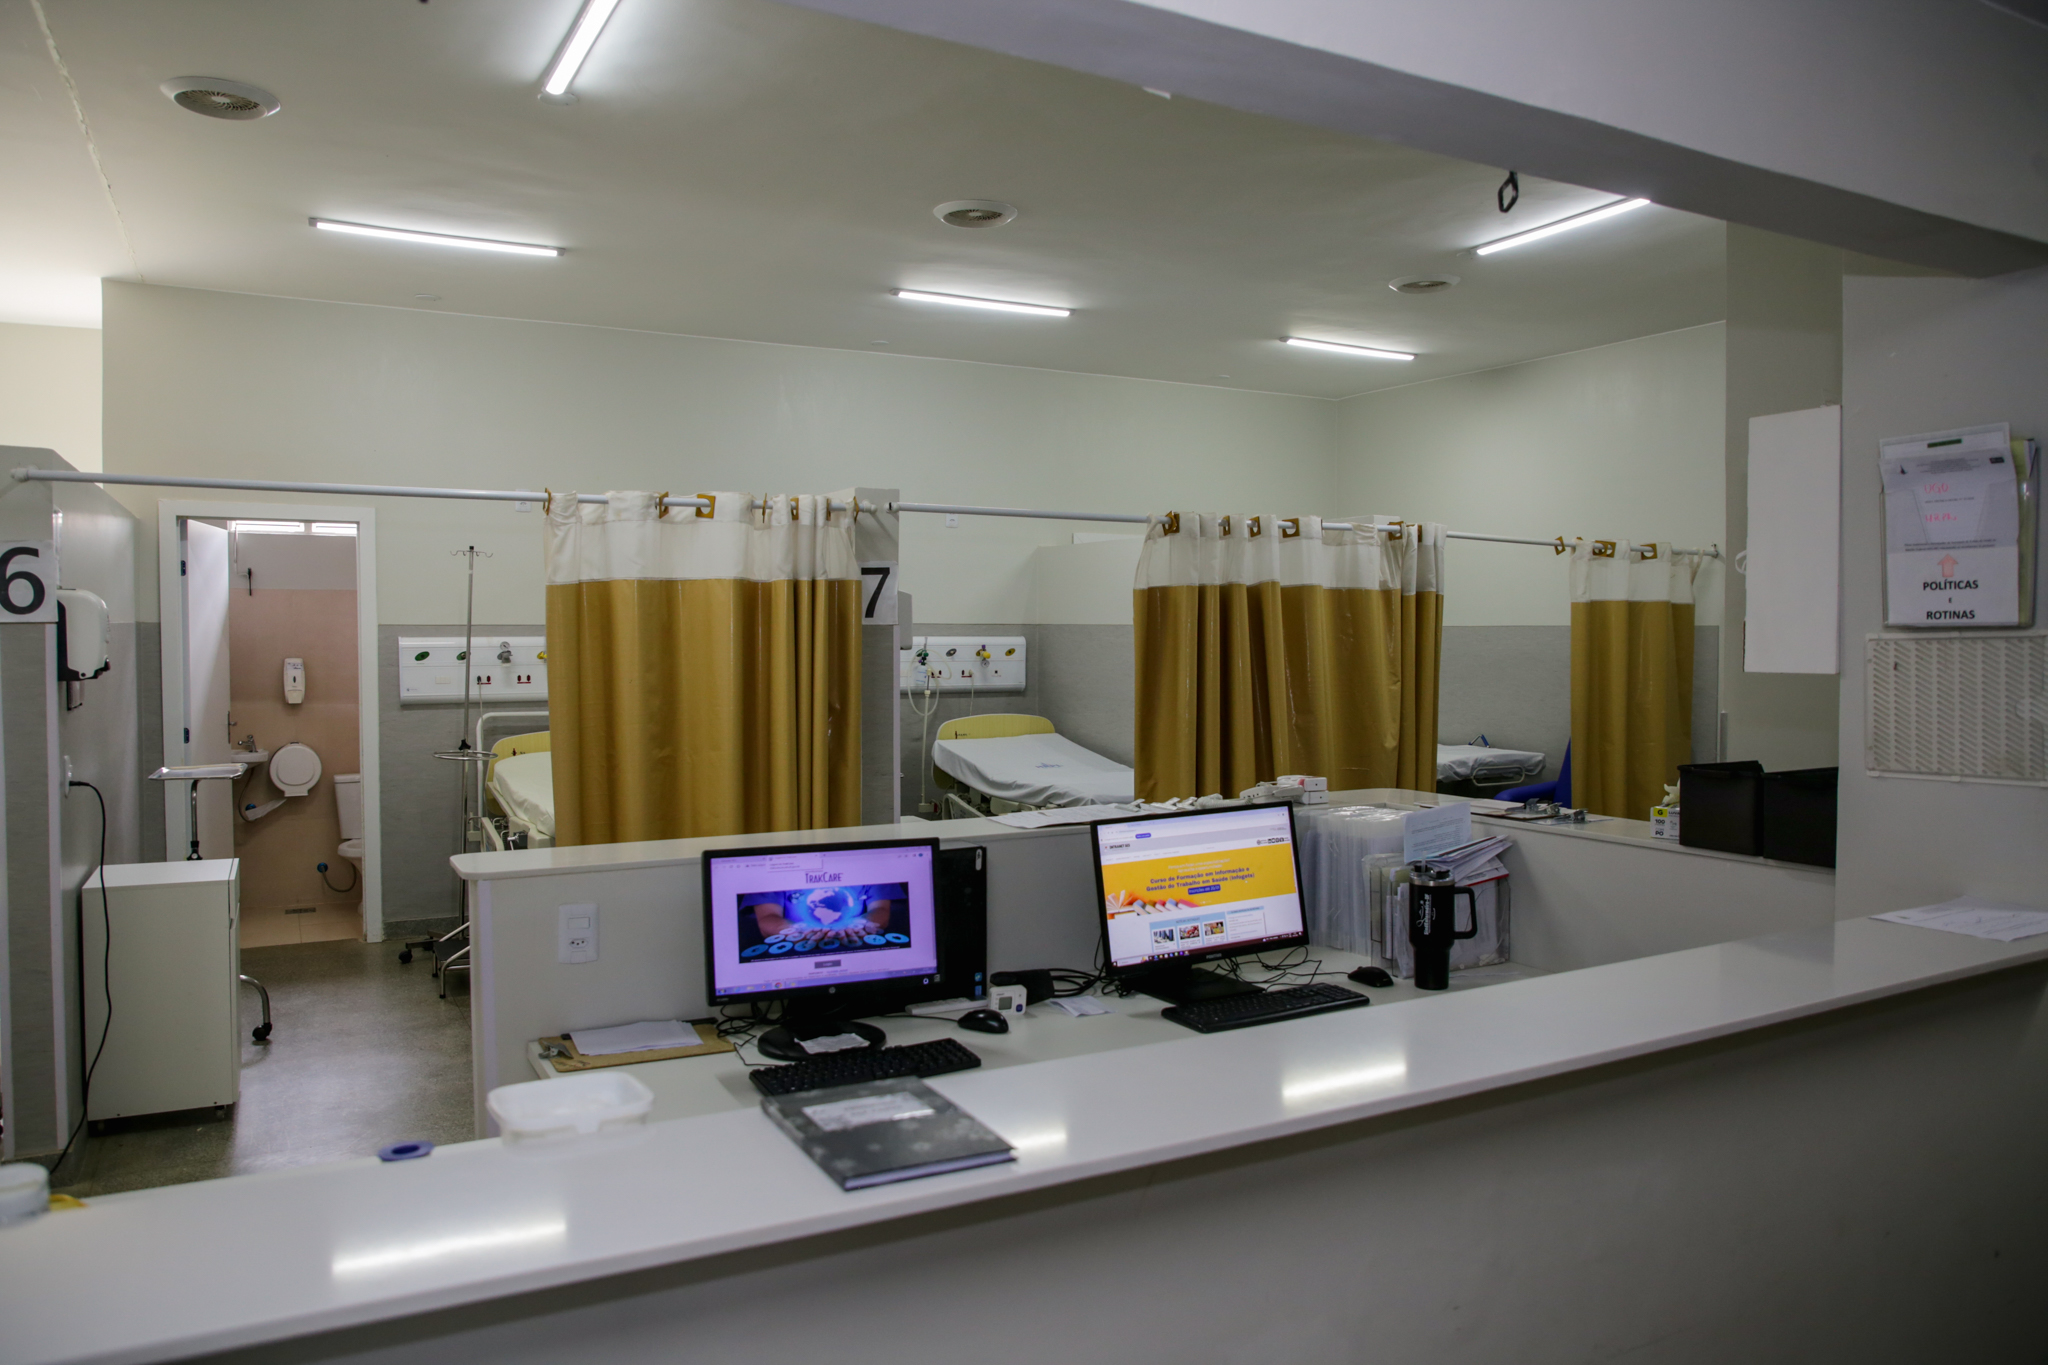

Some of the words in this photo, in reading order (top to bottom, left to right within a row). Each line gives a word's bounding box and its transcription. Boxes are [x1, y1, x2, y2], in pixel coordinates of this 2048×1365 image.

[0, 546, 45, 615] 6
[1923, 579, 1979, 591] POLÍTICAS
[861, 567, 890, 618] 7
[1926, 610, 1975, 620] ROTINAS
[1215, 867, 1245, 875] Informação
